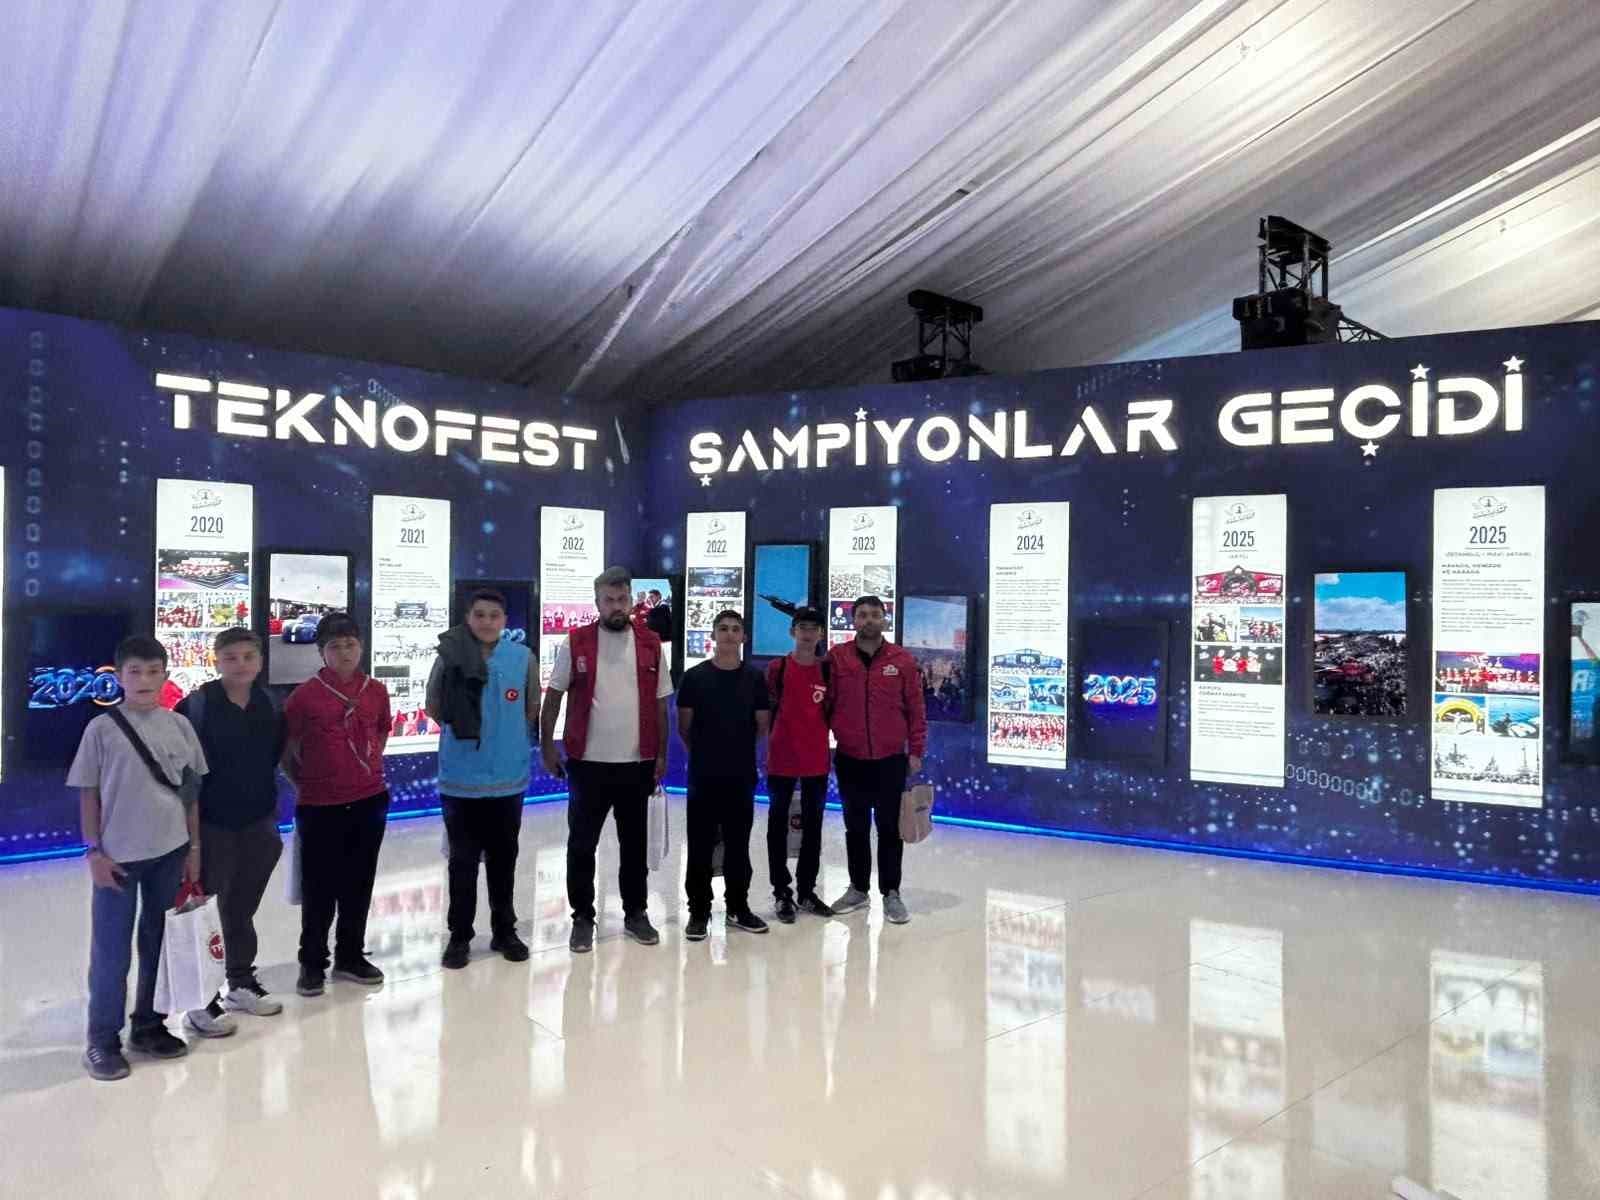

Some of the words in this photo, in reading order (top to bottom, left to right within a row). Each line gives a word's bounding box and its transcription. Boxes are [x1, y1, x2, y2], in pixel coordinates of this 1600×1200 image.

[155, 372, 598, 471] TEKNOFEST
[689, 399, 1179, 487] ŞAMPİYONLAR
[1218, 356, 1525, 456] GEÇİDİ
[190, 515, 224, 534] 2020
[400, 527, 426, 545] 2021
[562, 536, 585, 551] 2022
[852, 536, 876, 551] 2023
[1016, 535, 1045, 551] 2024
[1223, 530, 1256, 548] 2025
[1469, 525, 1508, 545] 2025
[706, 539, 728, 553] 2022
[28, 666, 124, 709] 2020
[1082, 674, 1157, 705] 2025
